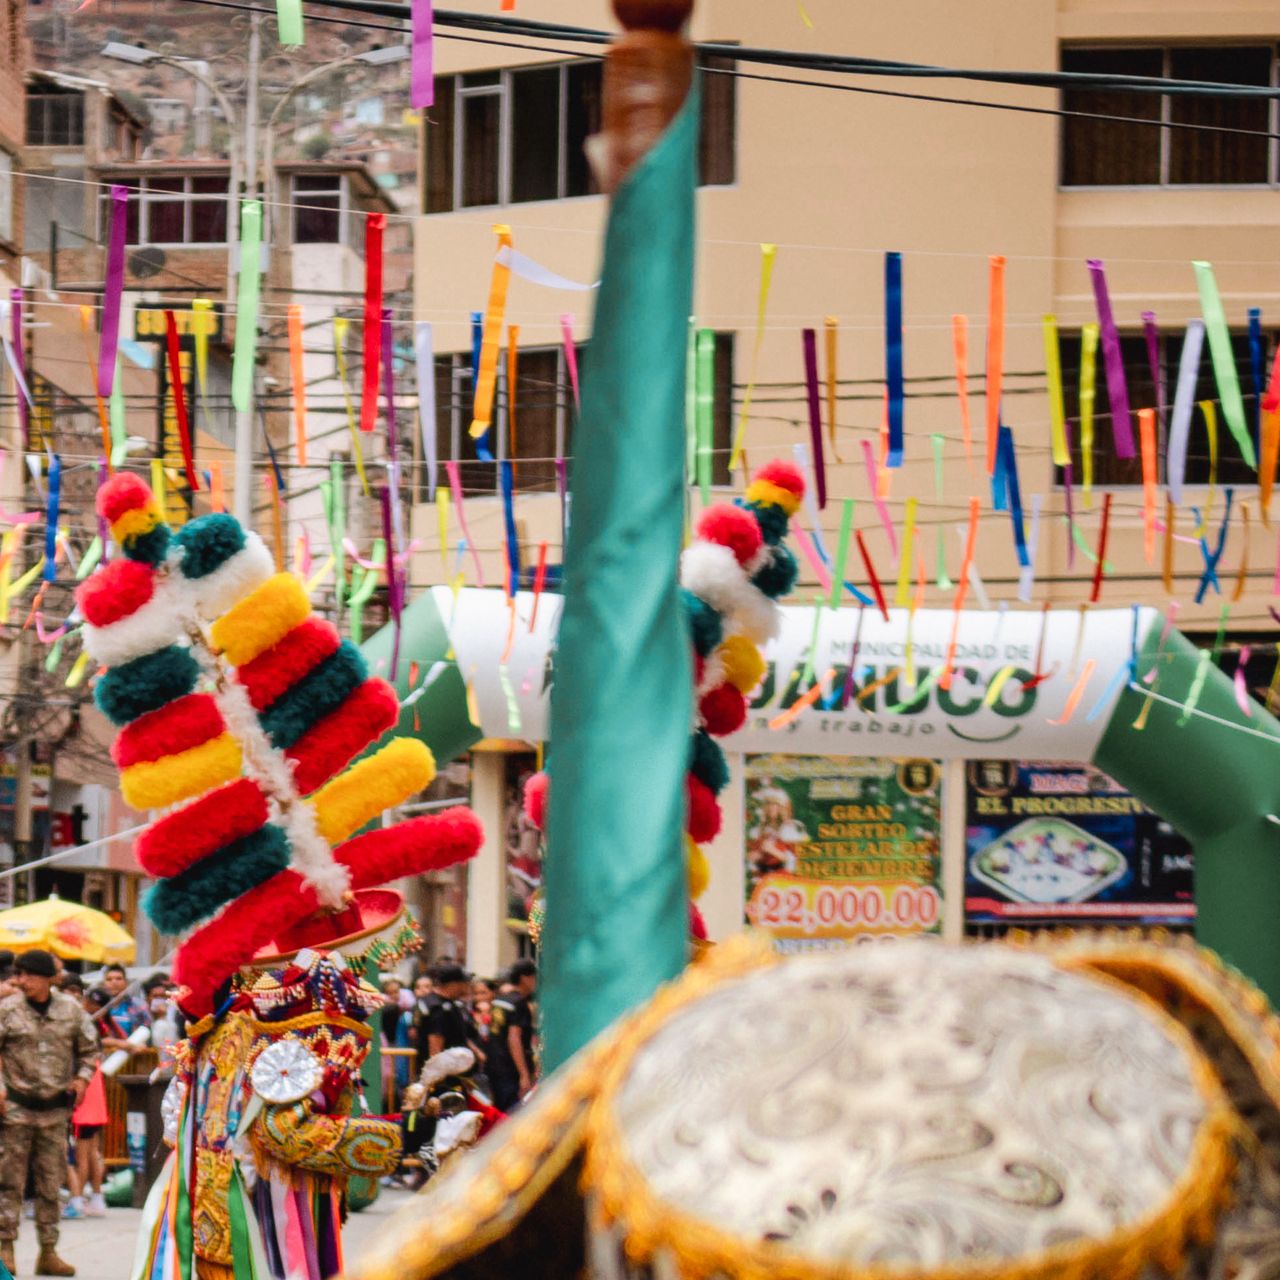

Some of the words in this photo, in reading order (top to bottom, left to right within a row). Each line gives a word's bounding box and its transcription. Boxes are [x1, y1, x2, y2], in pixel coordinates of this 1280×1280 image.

[830, 640, 999, 660] MNICPALDAD
[1004, 645, 1029, 660] DE
[821, 714, 935, 736] trabajo
[831, 805, 892, 820] GRAN
[976, 797, 1007, 814] EL
[1012, 797, 1146, 814] PROGRESIV
[818, 823, 906, 839] SORTEO
[795, 842, 892, 858] ESTELAR
[795, 861, 932, 877] DICIEMBRE
[761, 885, 938, 931] 22,000.00
